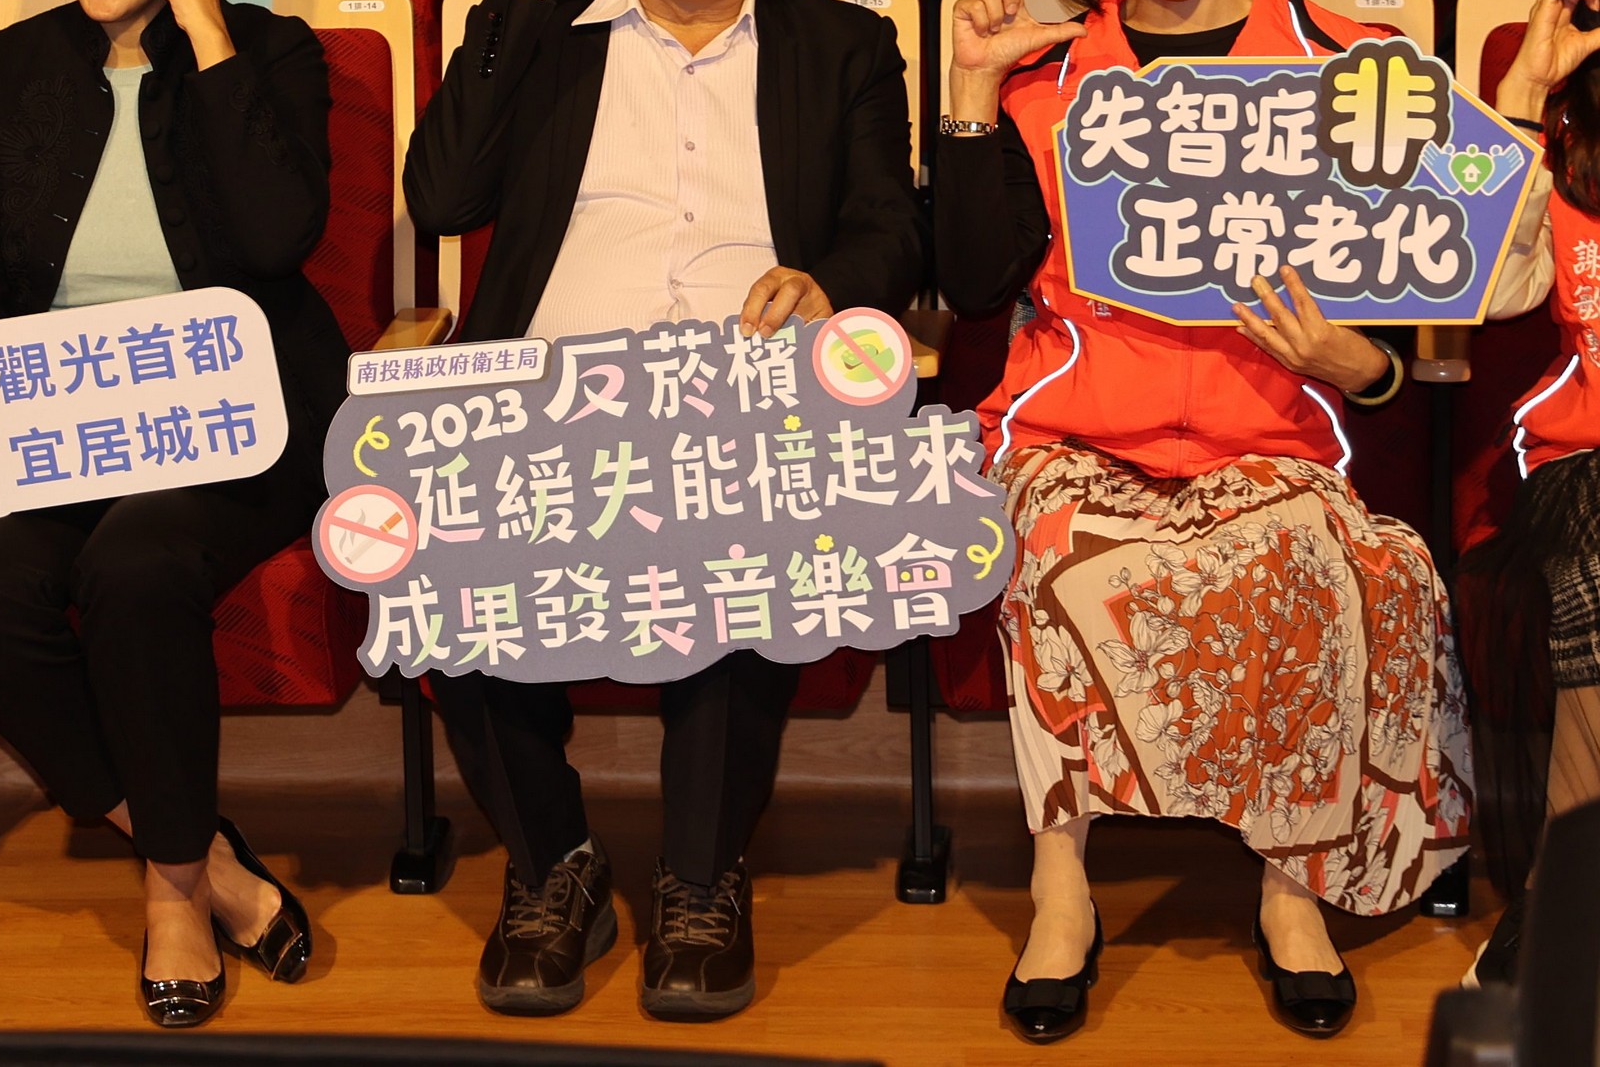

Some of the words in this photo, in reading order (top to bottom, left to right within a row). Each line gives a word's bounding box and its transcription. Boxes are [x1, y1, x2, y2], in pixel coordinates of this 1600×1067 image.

[1079, 56, 1437, 178] 失智症非
[1125, 190, 1459, 288] 正常老化
[357, 346, 539, 384] 南投縣政府衛生局
[397, 389, 529, 457] 2023
[543, 324, 801, 425] 反菸檳
[9, 398, 258, 487] 宜居城市
[409, 414, 997, 550] 延緩失能憶起來
[367, 532, 958, 667] 成果發表音樂會
